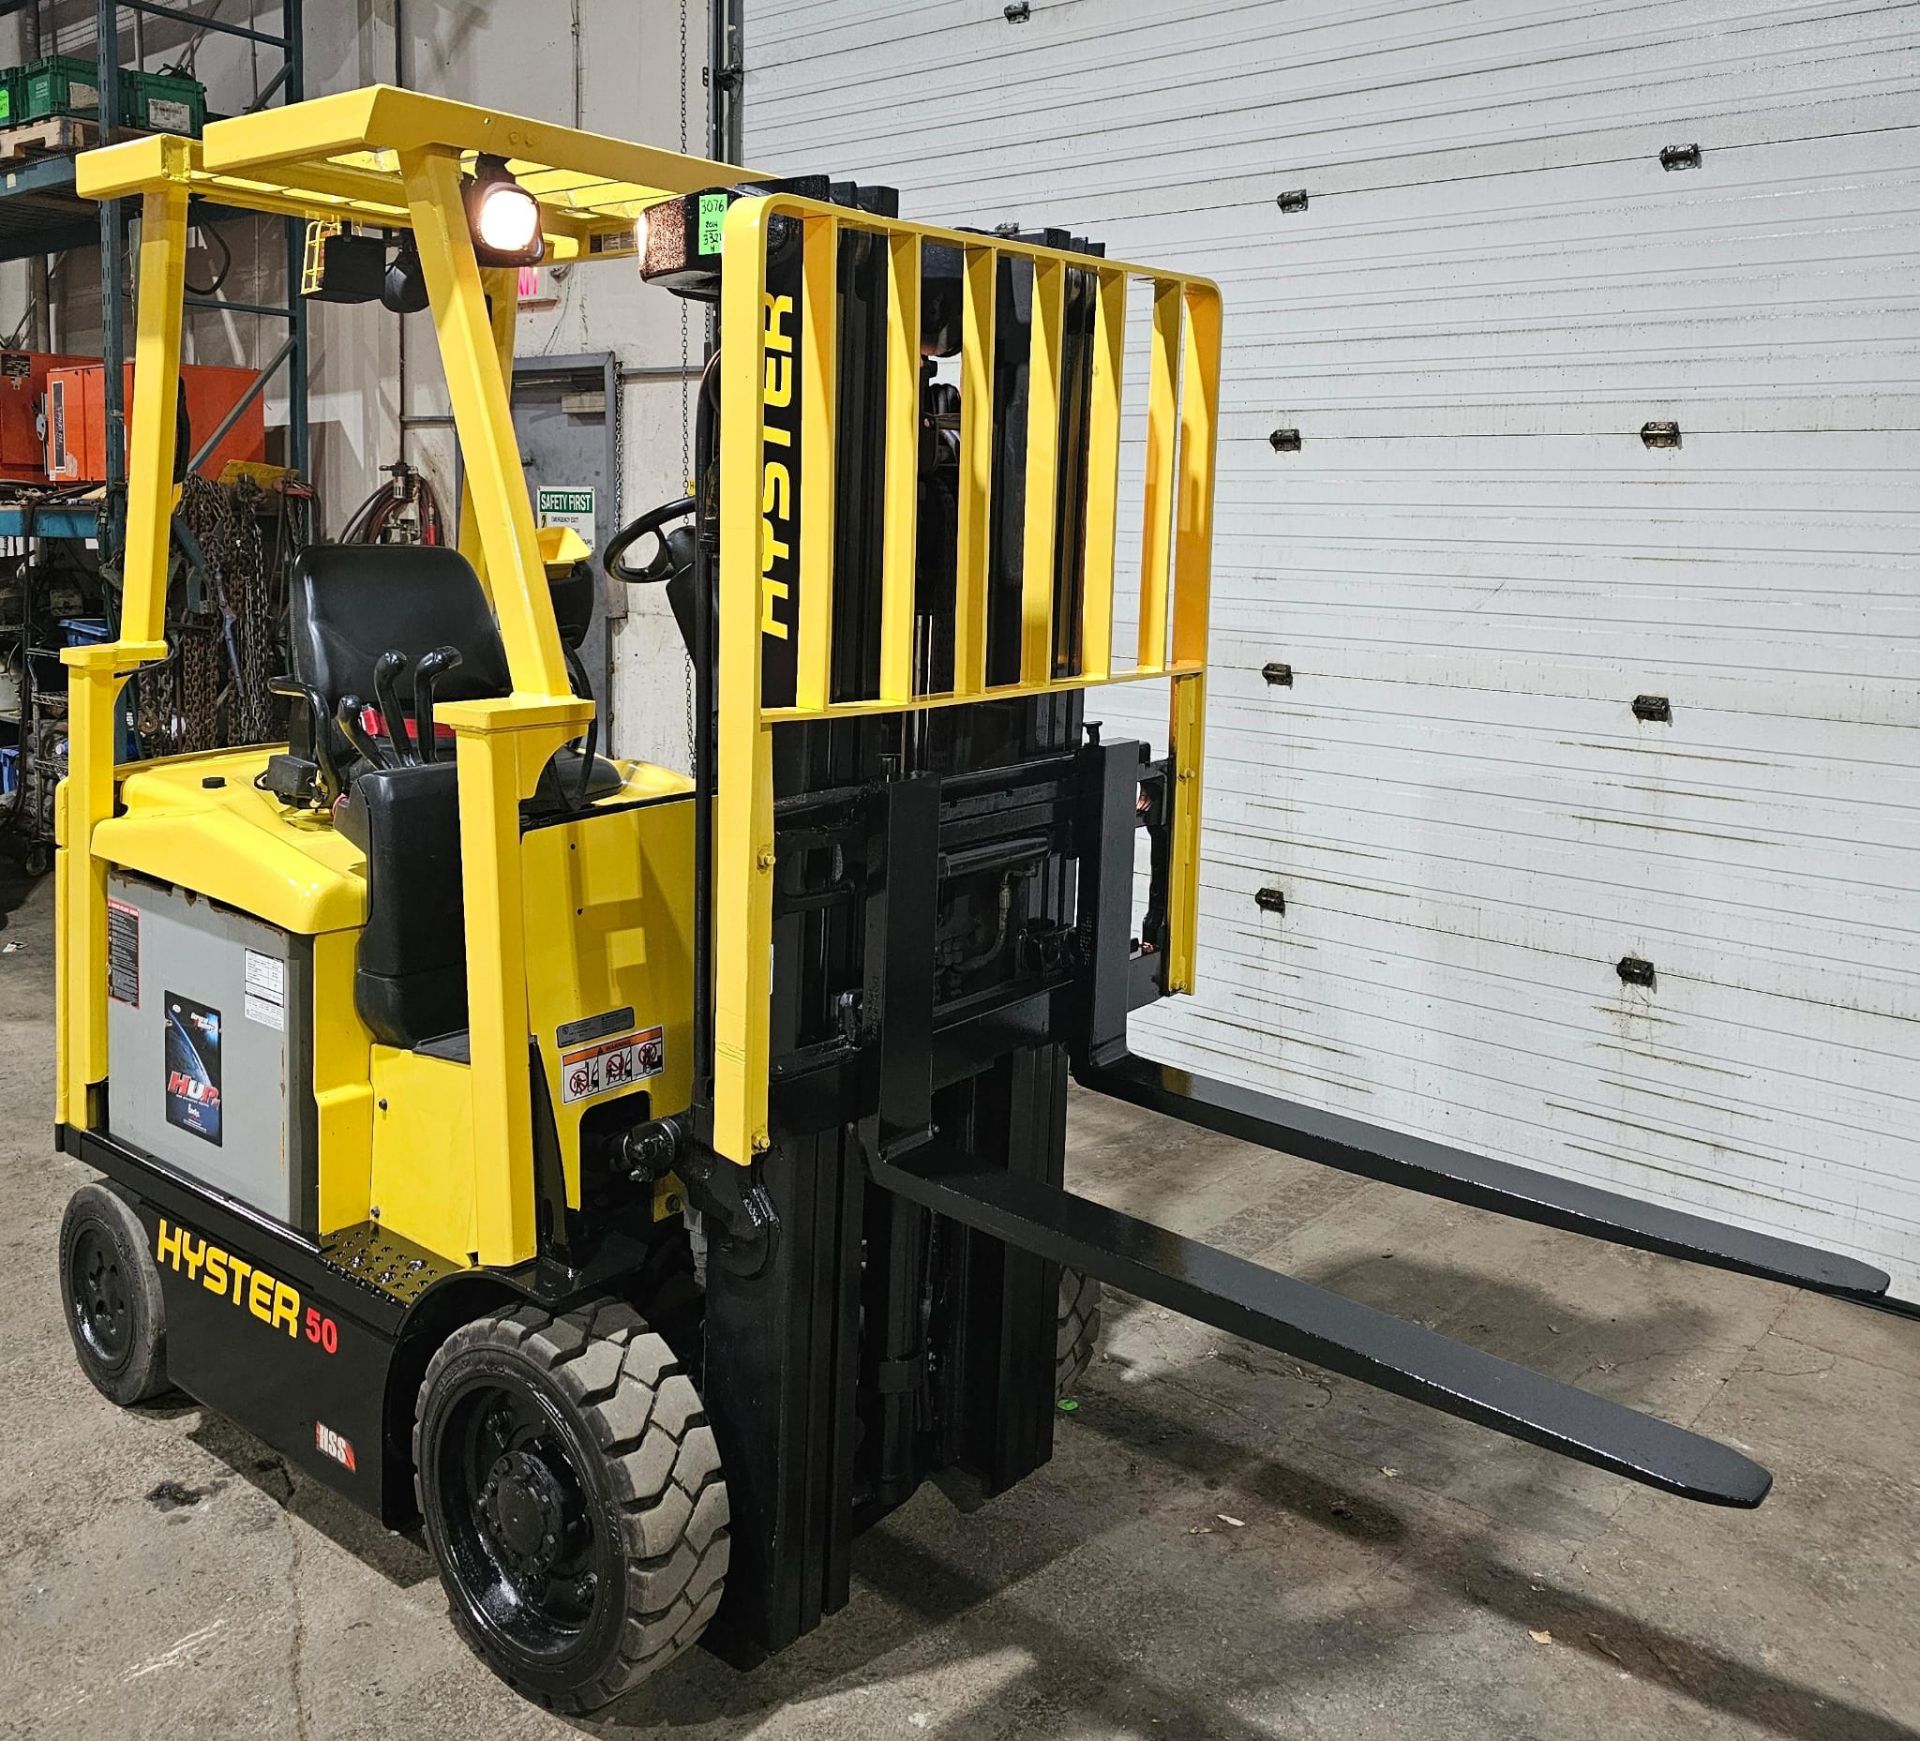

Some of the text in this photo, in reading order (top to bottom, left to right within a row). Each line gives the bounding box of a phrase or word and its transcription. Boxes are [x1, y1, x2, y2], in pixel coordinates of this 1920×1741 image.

[701, 199, 725, 214] 3076
[541, 494, 591, 511] SAFETY FIRST
[157, 1218, 338, 1354] HYSTER 50
[319, 1424, 346, 1464] HSS
